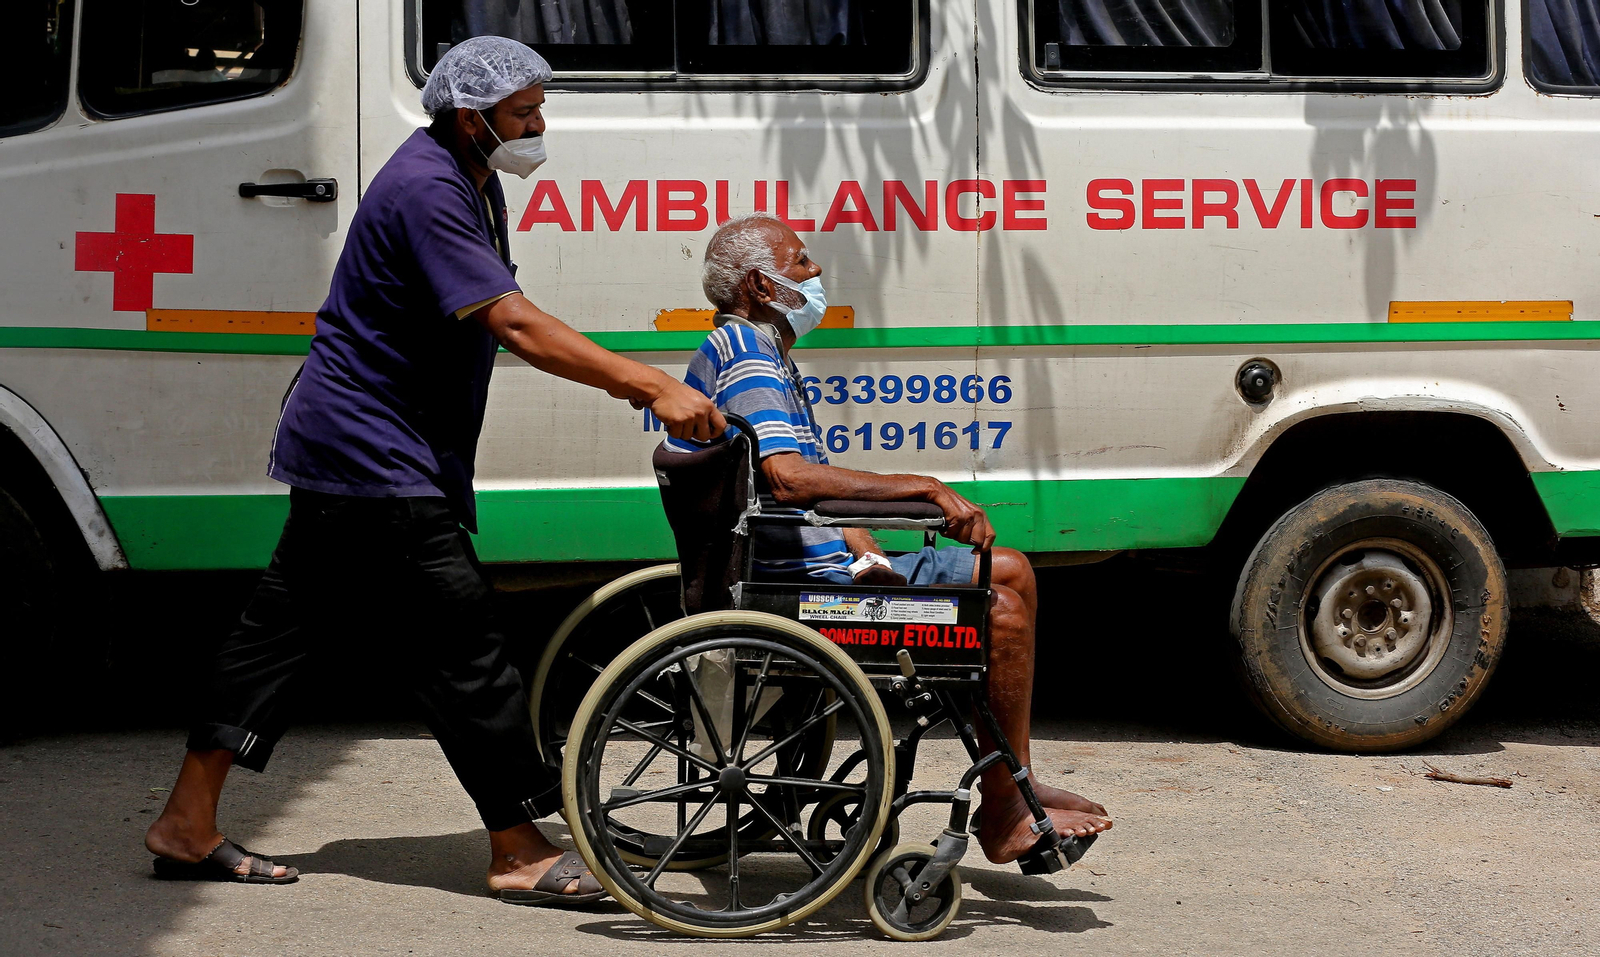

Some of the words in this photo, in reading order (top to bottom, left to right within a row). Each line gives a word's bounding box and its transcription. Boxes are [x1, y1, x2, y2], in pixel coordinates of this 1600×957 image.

[516, 179, 1048, 232] AMBULANCE
[1086, 178, 1417, 230] SERVICE
[819, 628, 878, 644] DONATED
[881, 630, 899, 645] BY
[903, 624, 981, 648] ETO.LTD.
